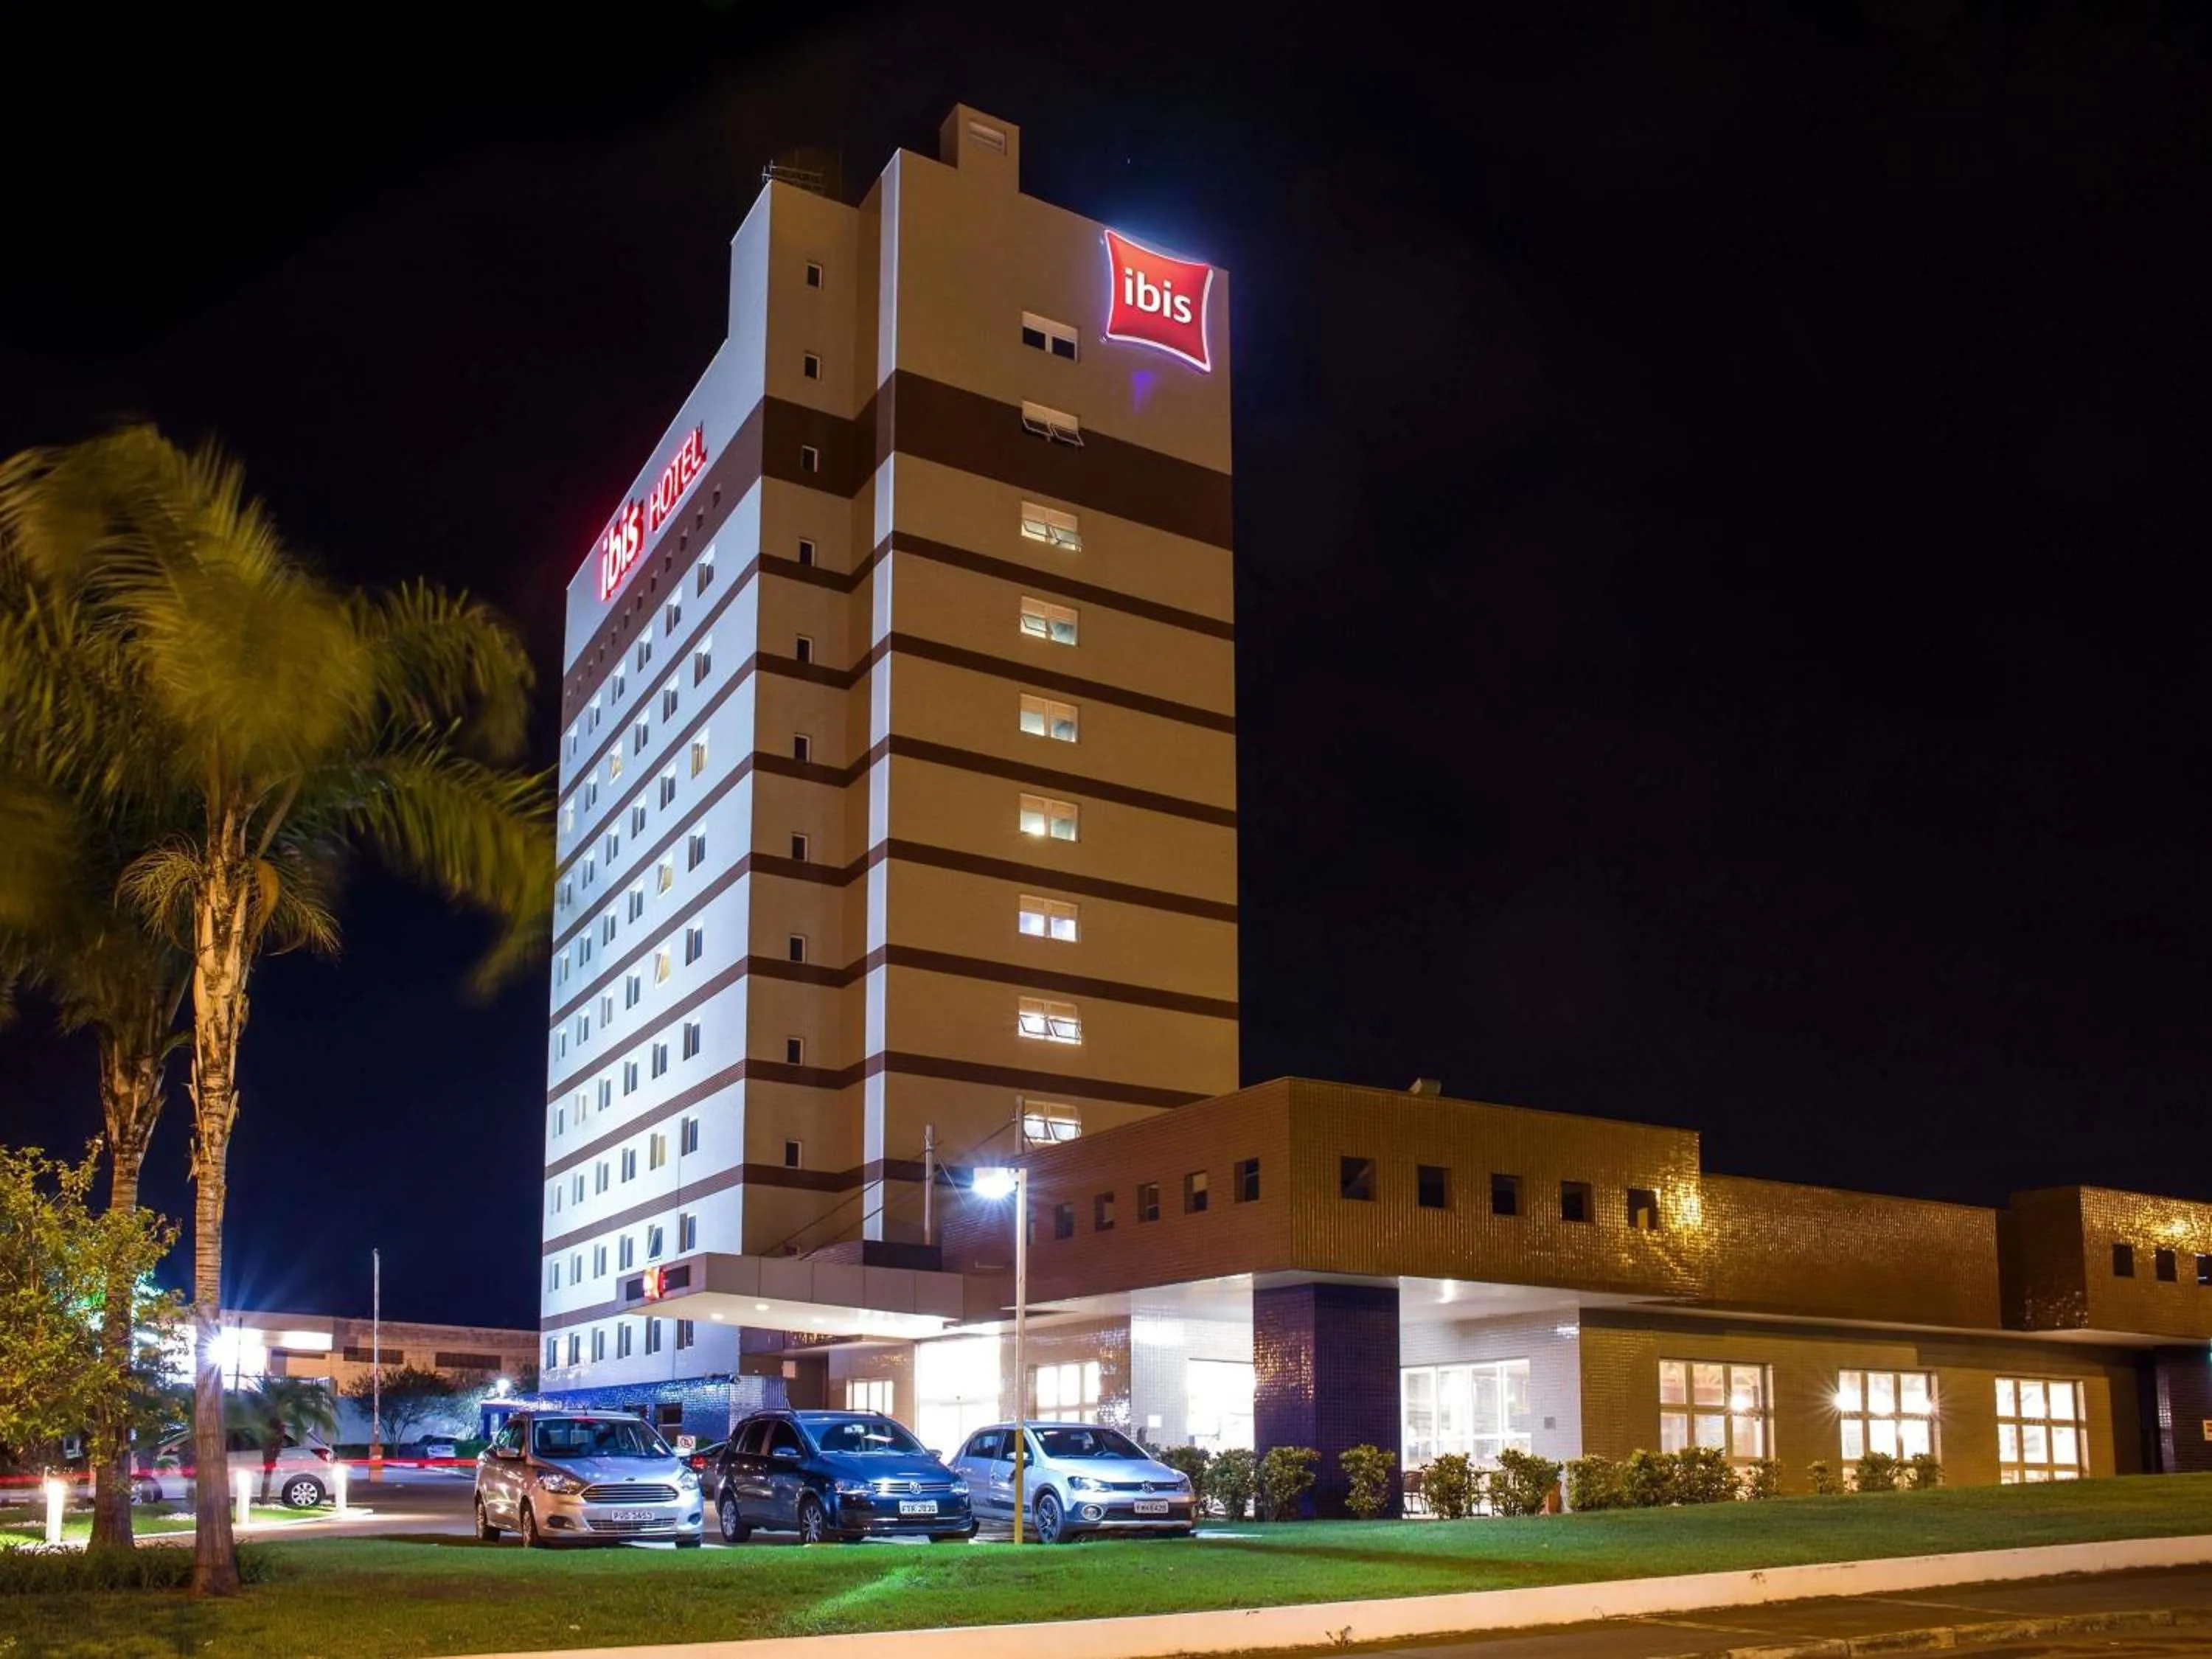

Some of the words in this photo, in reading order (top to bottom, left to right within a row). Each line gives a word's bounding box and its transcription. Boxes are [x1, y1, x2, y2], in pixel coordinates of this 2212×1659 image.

[1124, 267, 1192, 324] ibis
[601, 501, 643, 602] ibis
[649, 425, 706, 532] HOTEL
